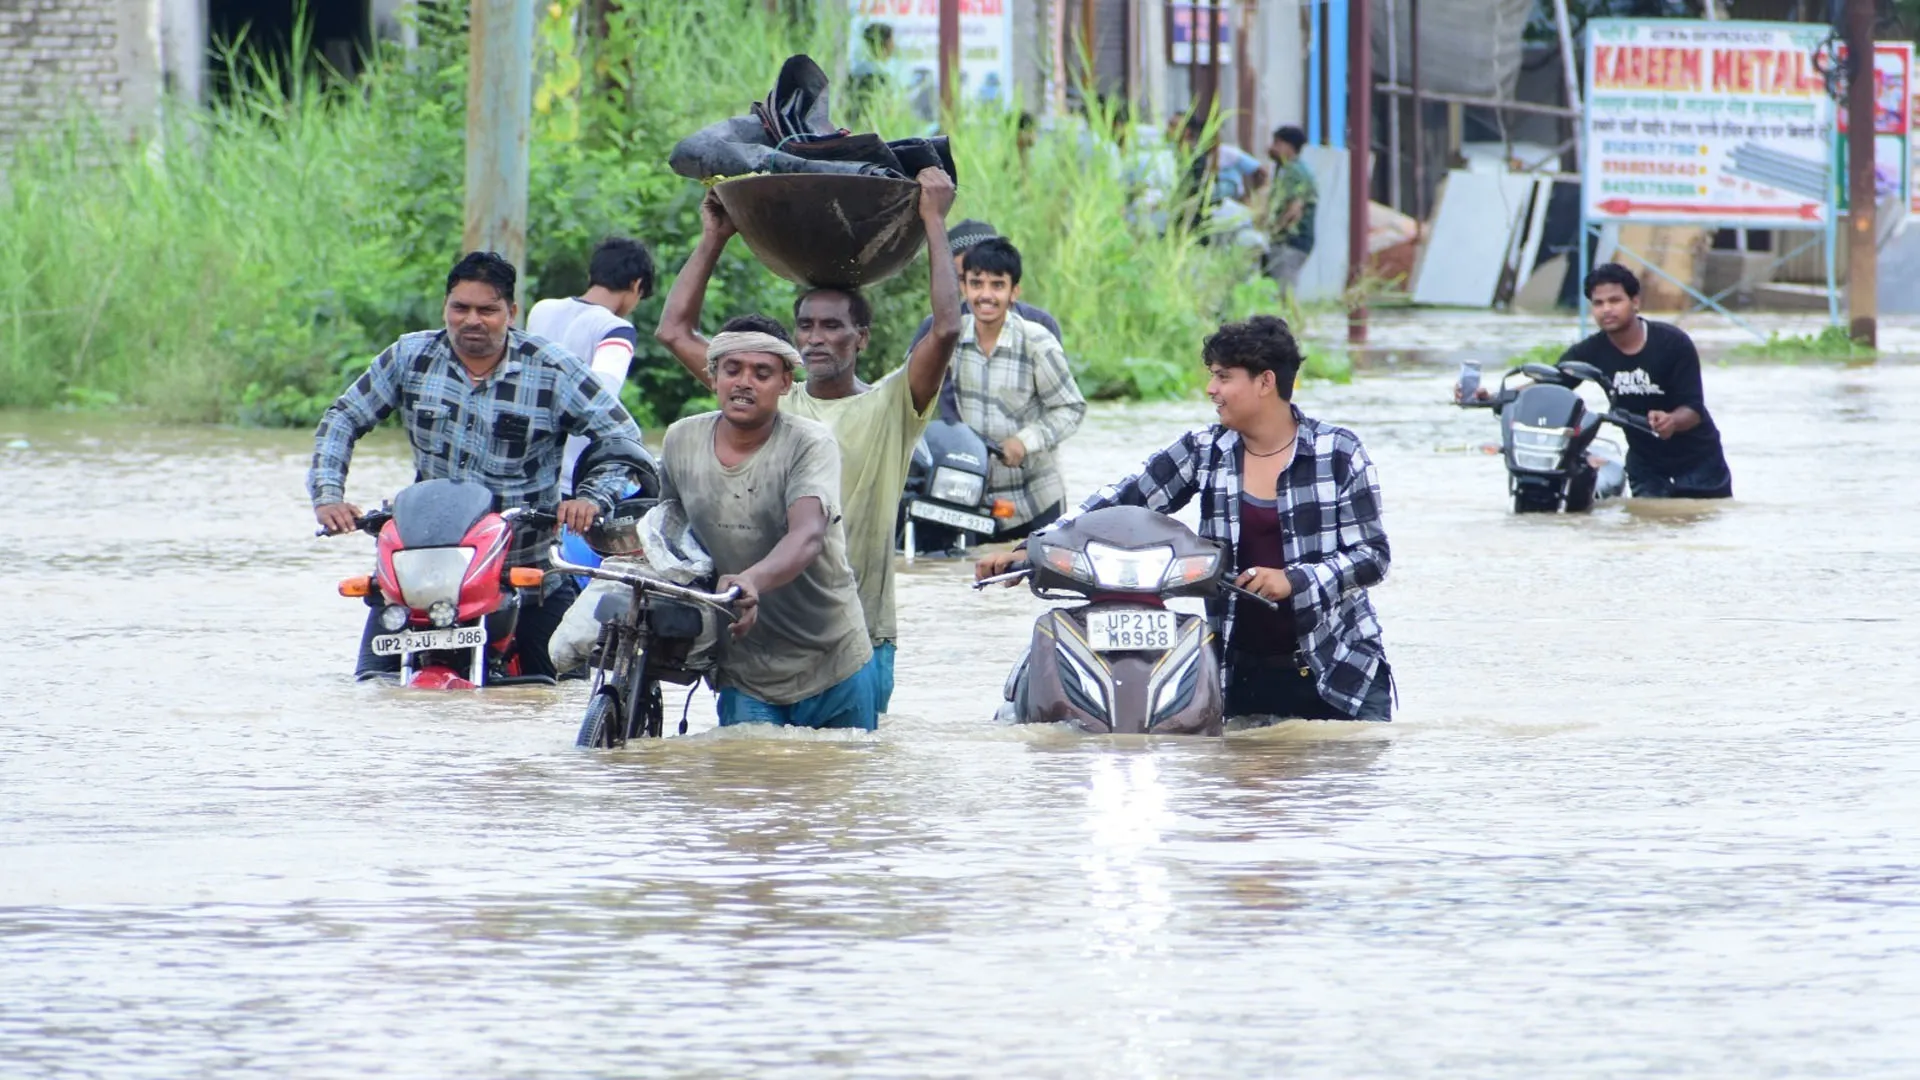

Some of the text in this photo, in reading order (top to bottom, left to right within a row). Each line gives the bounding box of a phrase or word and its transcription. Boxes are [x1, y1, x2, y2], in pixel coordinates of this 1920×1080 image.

[1594, 45, 1702, 91] KAREEM
[1108, 614, 1168, 630] UP21C
[1109, 631, 1168, 647] M8968
